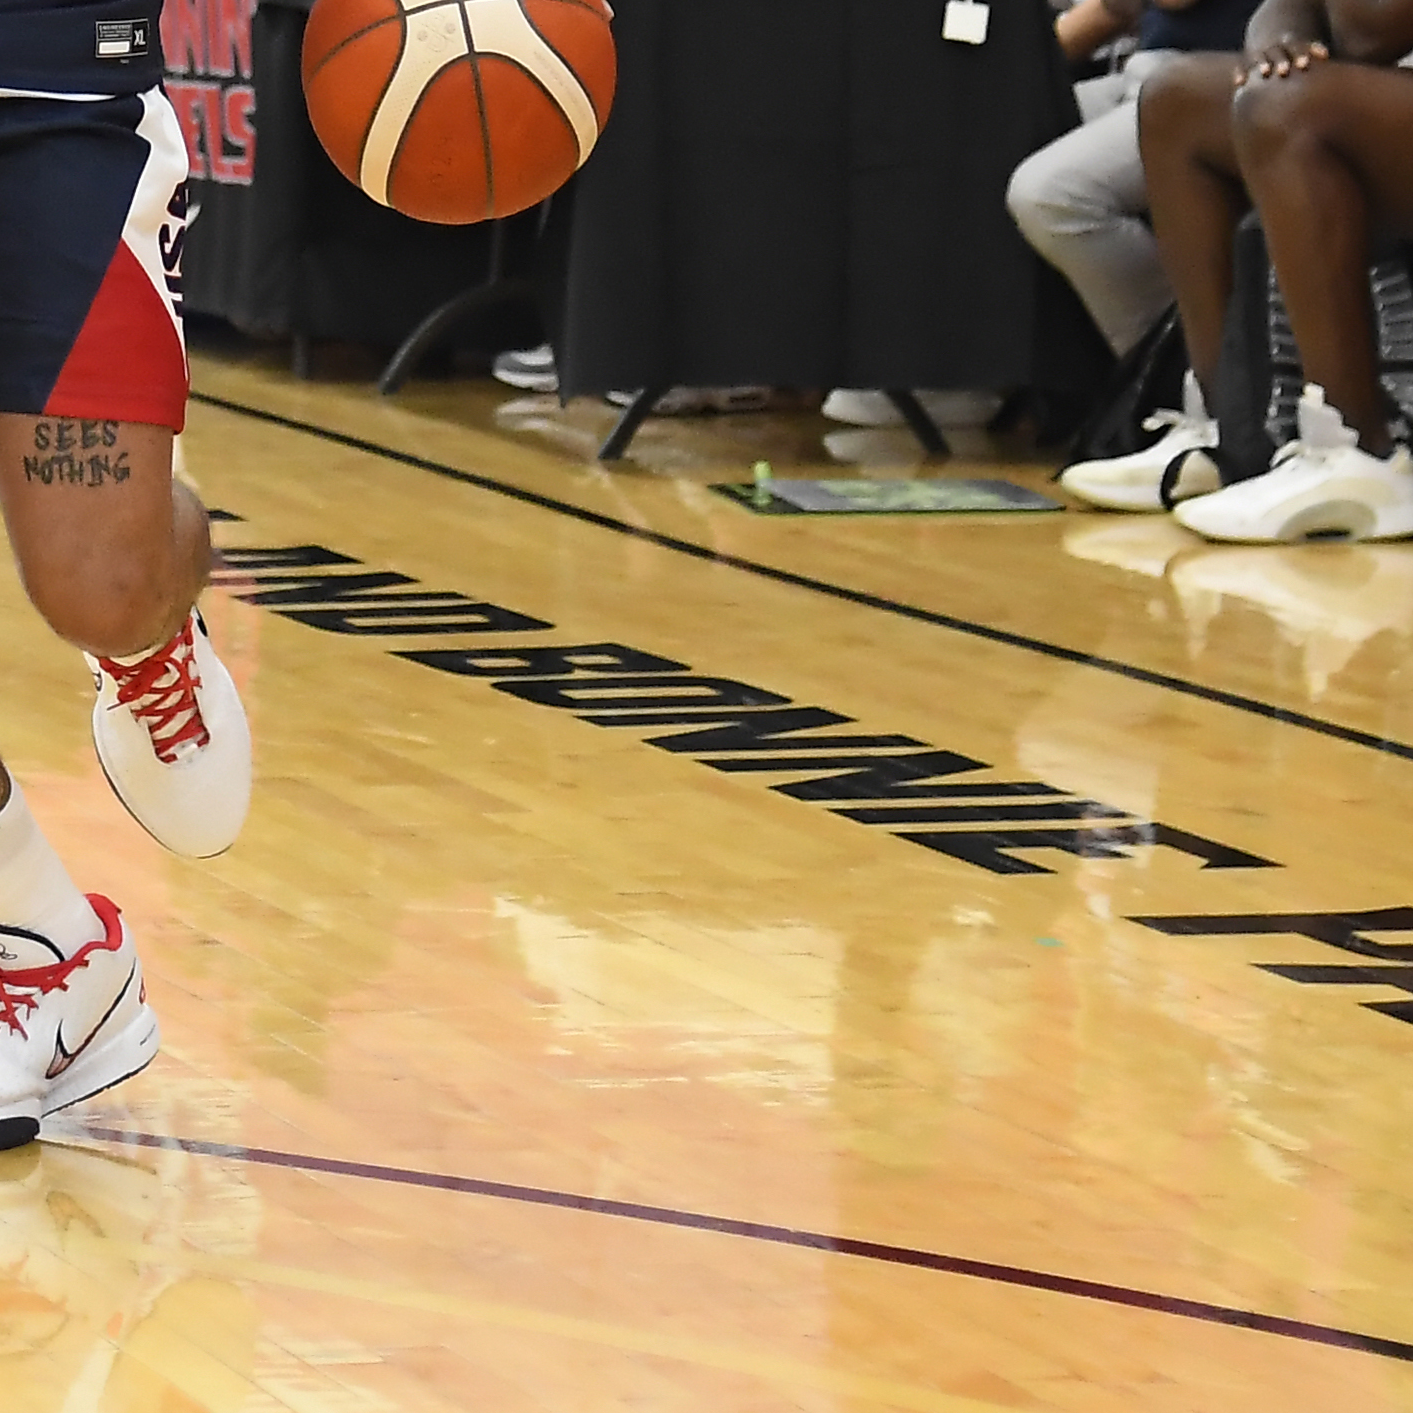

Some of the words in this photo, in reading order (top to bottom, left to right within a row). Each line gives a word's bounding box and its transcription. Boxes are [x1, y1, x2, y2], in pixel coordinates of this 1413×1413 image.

[133, 29, 146, 46] XL
[163, 80, 256, 185] ELS
[35, 419, 119, 451] SEES
[23, 452, 130, 487] NOTHING
[388, 642, 1284, 875] BONNIE
